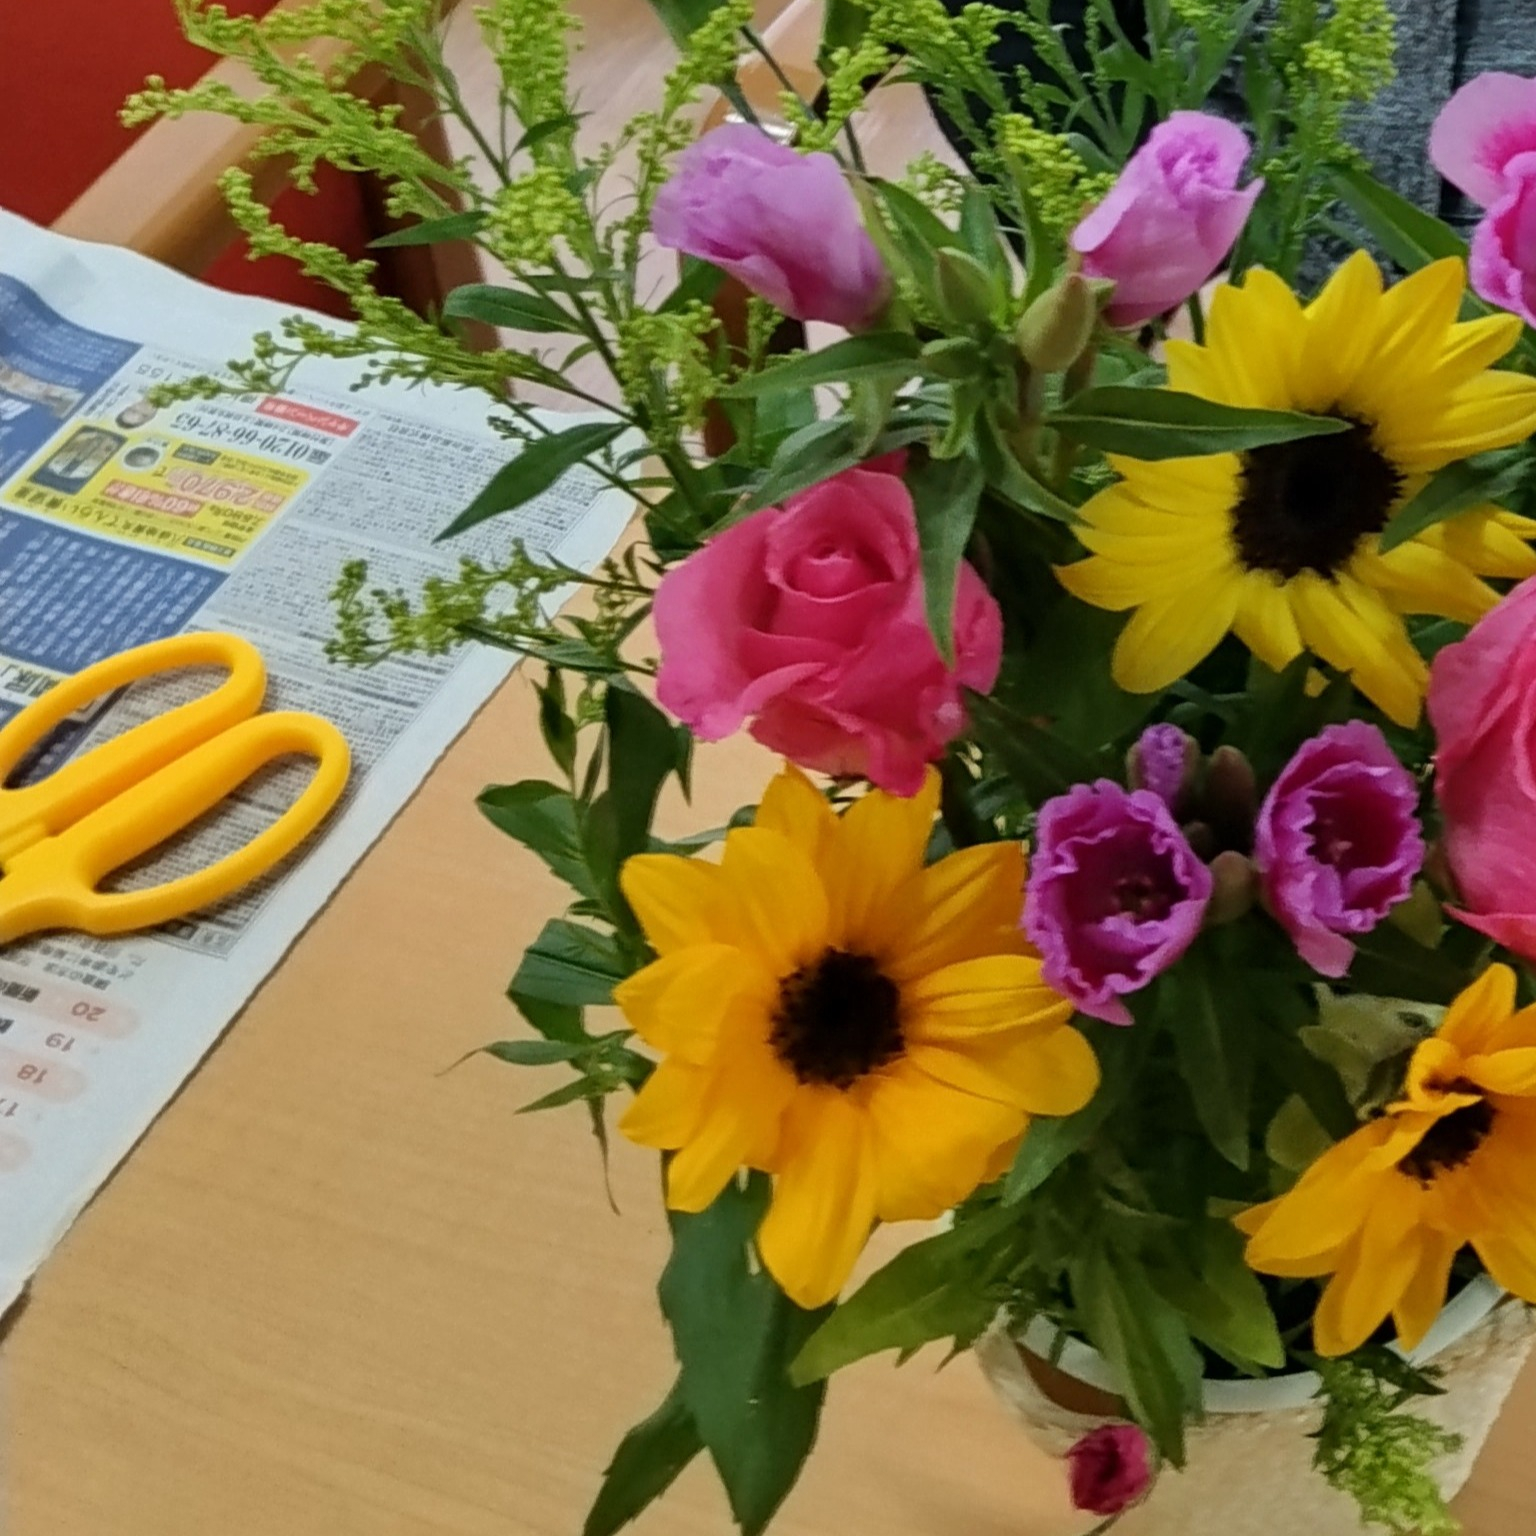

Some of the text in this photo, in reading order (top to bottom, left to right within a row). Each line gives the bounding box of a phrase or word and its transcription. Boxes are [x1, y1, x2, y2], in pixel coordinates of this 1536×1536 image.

[170, 412, 312, 461] 0120-66-87-65
[71, 1001, 107, 1022] 20
[45, 1032, 76, 1053] 19
[17, 1064, 48, 1085] 18
